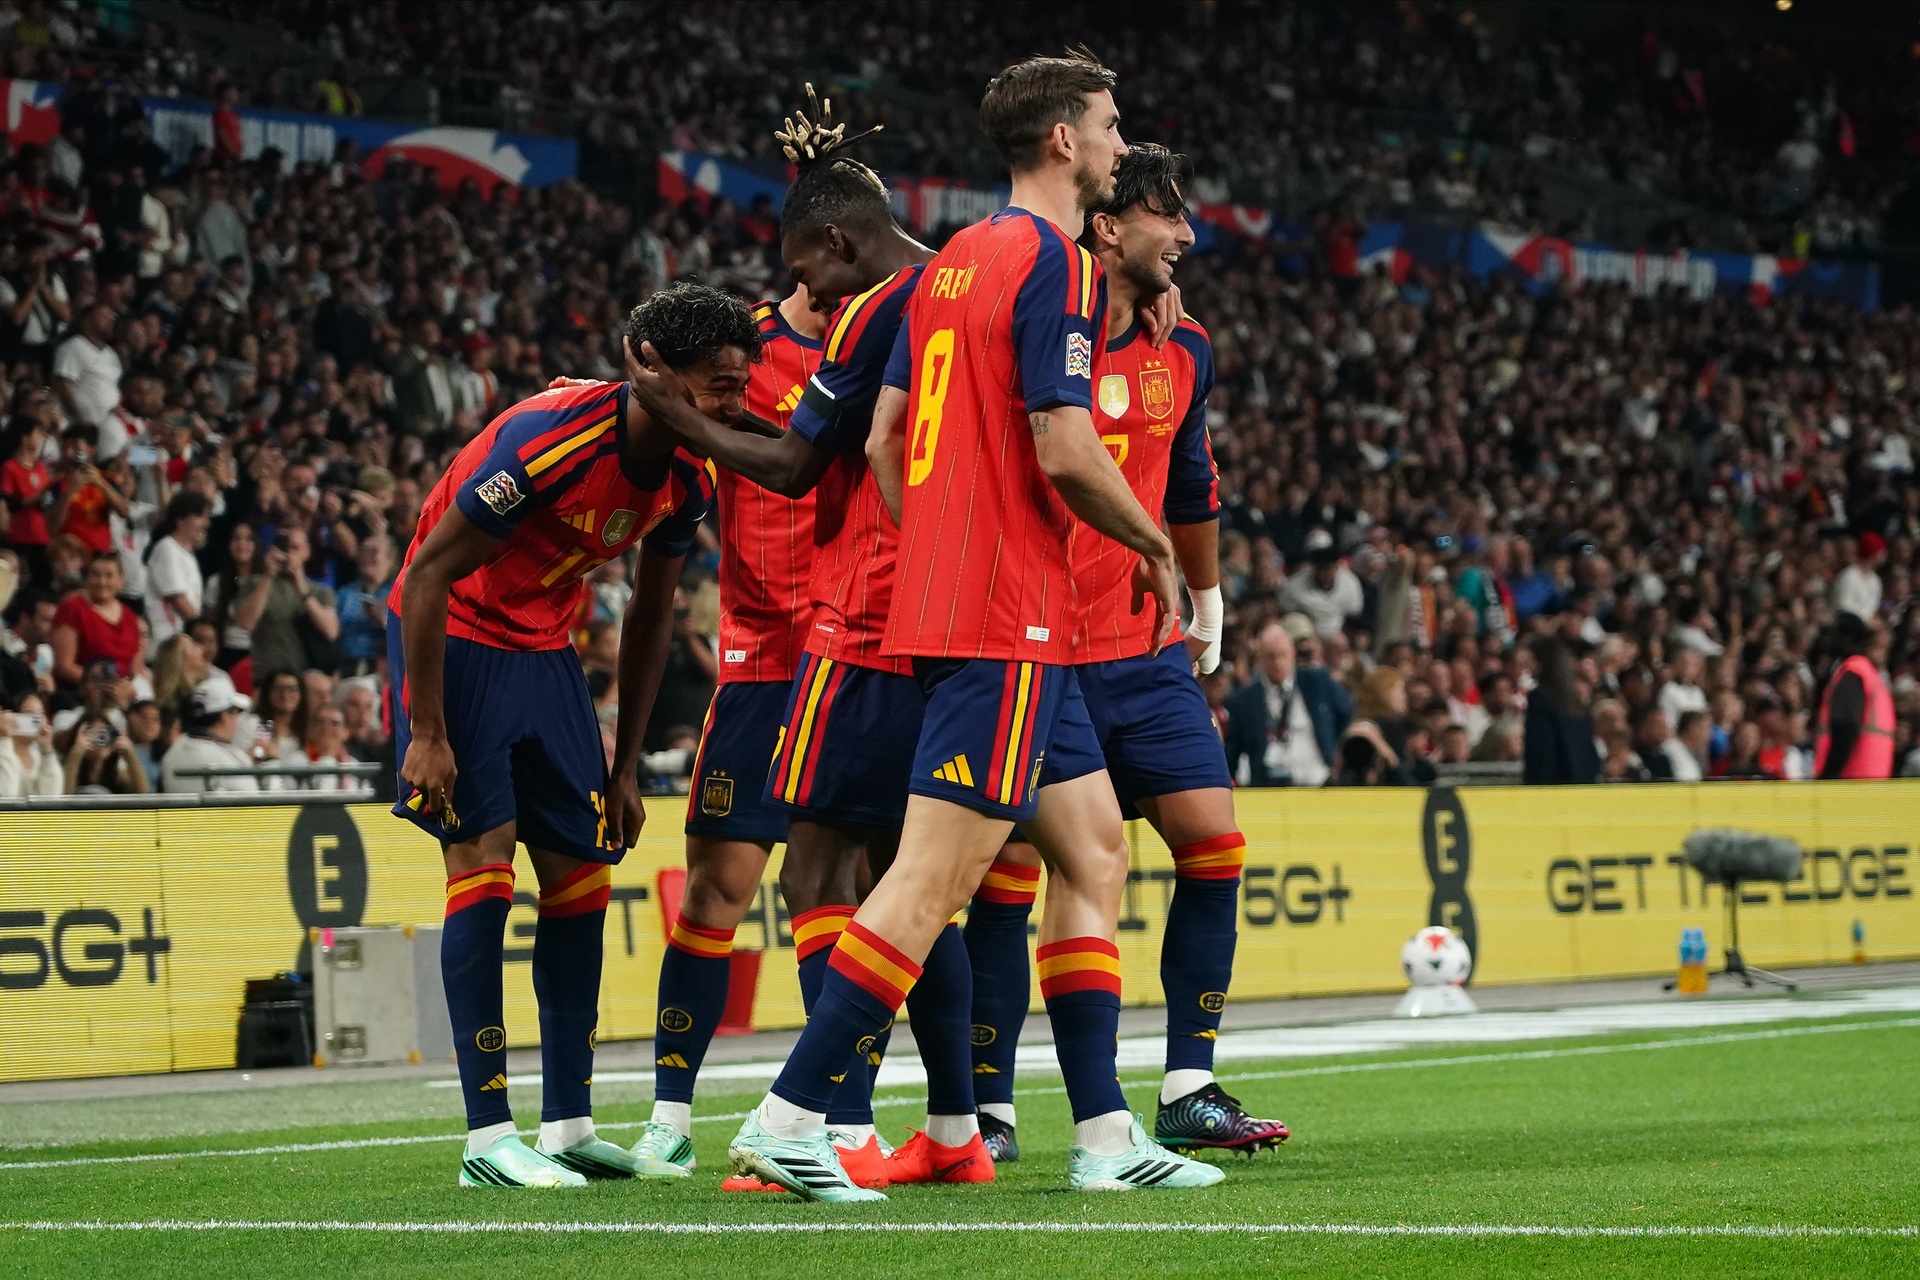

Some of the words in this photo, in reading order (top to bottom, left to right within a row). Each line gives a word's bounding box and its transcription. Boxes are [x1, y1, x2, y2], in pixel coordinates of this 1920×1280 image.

[907, 327, 955, 487] 8
[1243, 862, 1353, 926] 5G+
[1547, 855, 1654, 914] GET
[0, 906, 172, 989] 5G+
